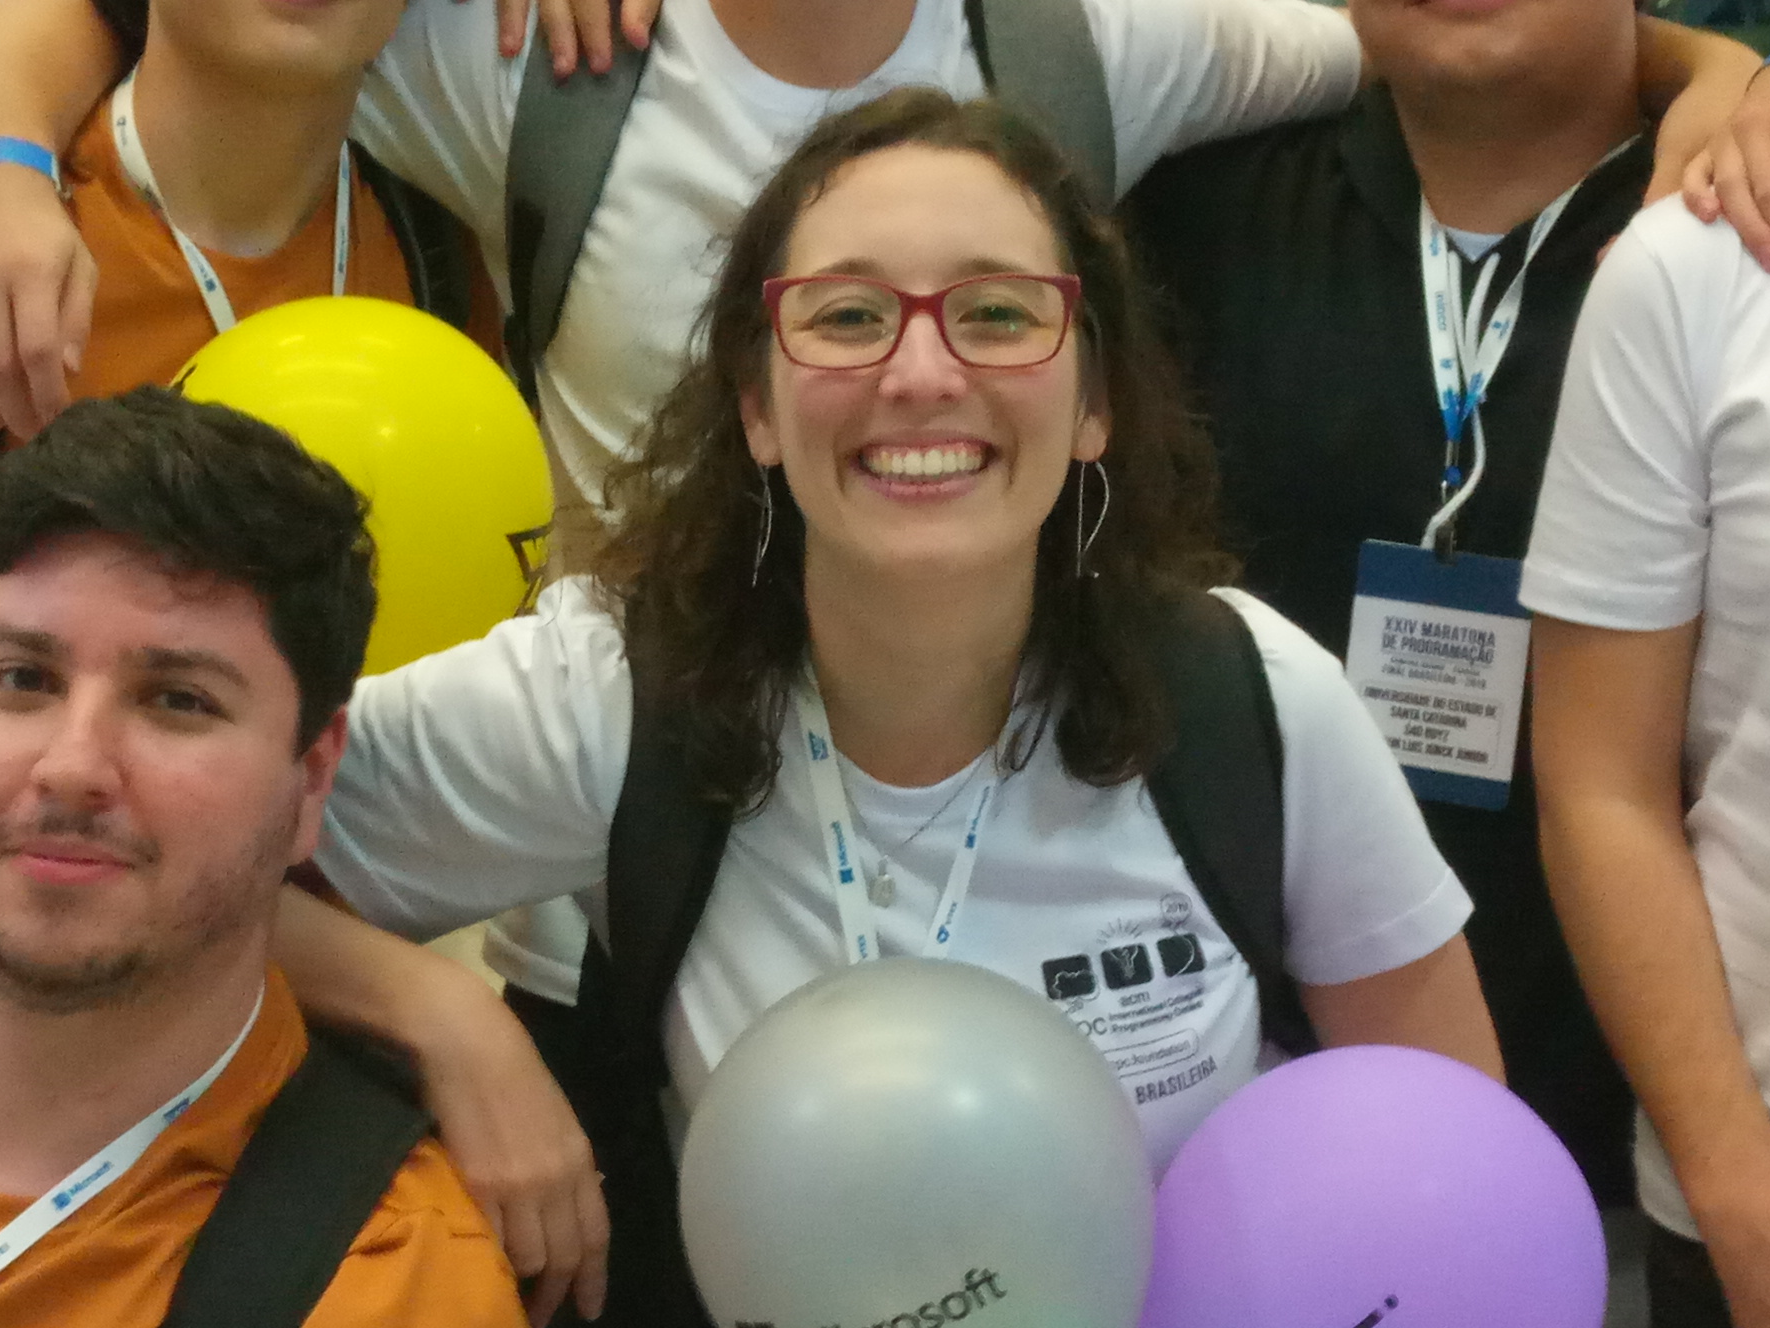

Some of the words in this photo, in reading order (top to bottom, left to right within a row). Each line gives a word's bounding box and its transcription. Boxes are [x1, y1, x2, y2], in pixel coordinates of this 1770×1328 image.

[1382, 632, 1397, 649] DE
[1384, 615, 1418, 634] XXIV
[1421, 621, 1496, 647] MARATONA
[1135, 1055, 1218, 1105] BRASILEIRA
